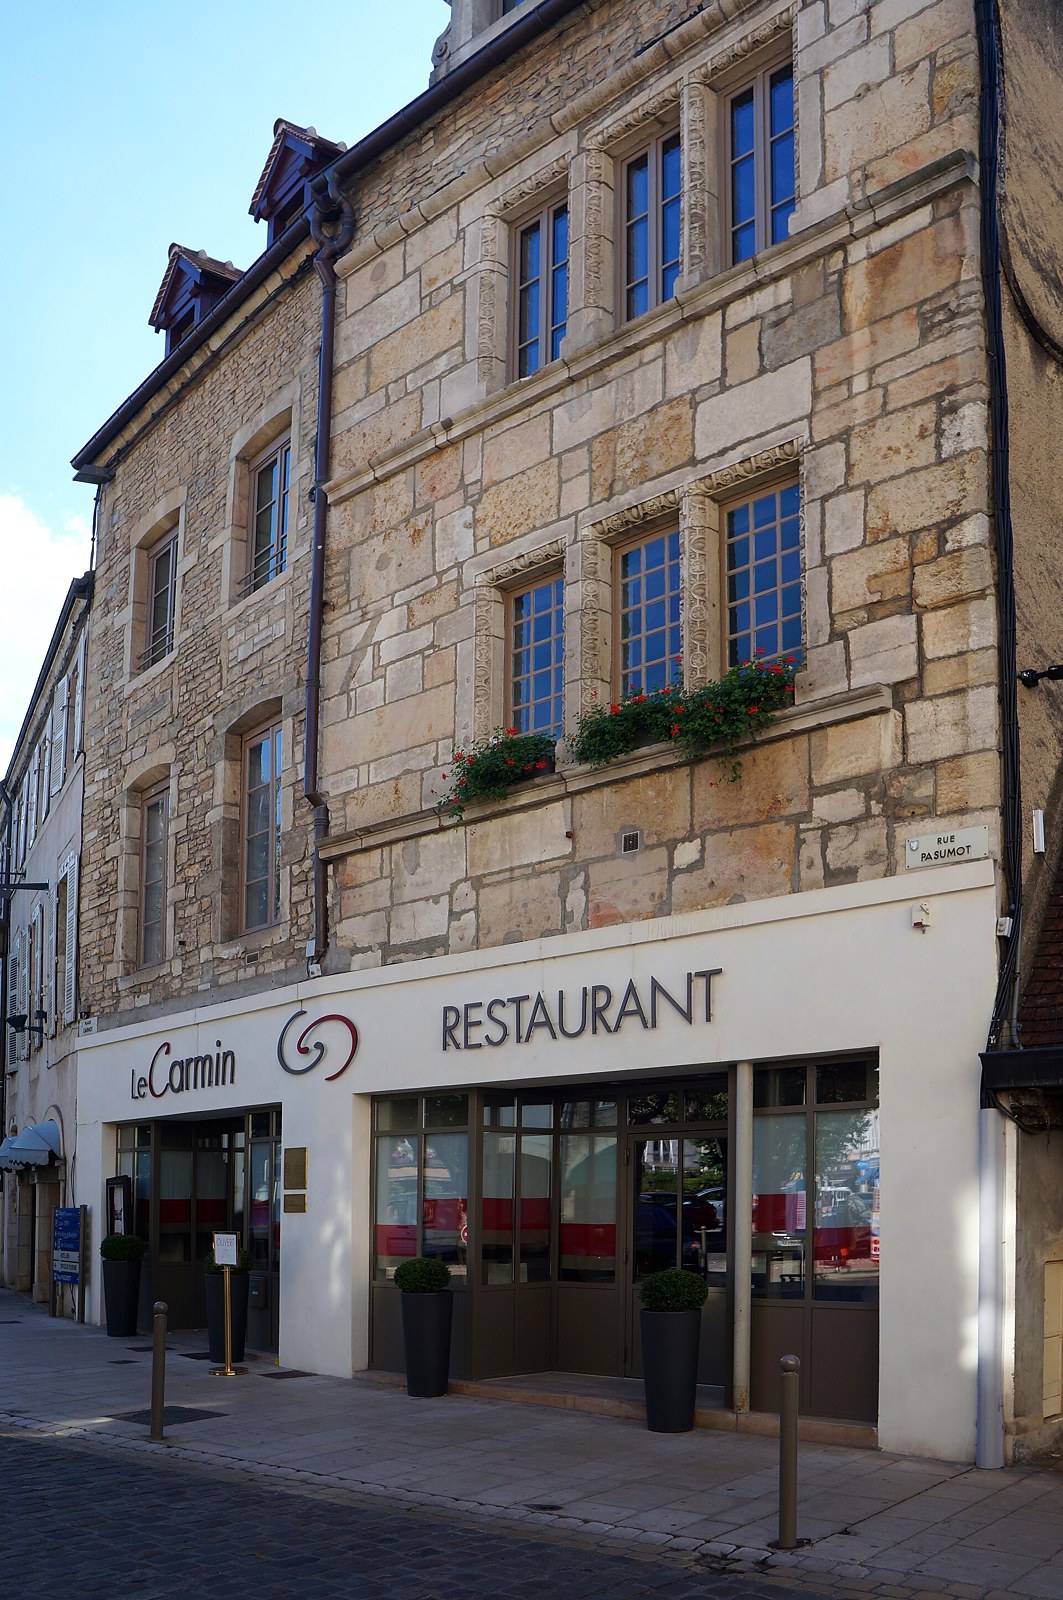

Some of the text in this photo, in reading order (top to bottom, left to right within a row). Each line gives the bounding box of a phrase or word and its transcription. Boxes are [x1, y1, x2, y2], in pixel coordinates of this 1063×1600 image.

[937, 835, 955, 845] RUE
[921, 845, 971, 862] PASUMOT
[442, 968, 723, 1050] RESTAURANT
[131, 1040, 235, 1100] Le Carmin
[216, 1237, 235, 1247] OUVERT
